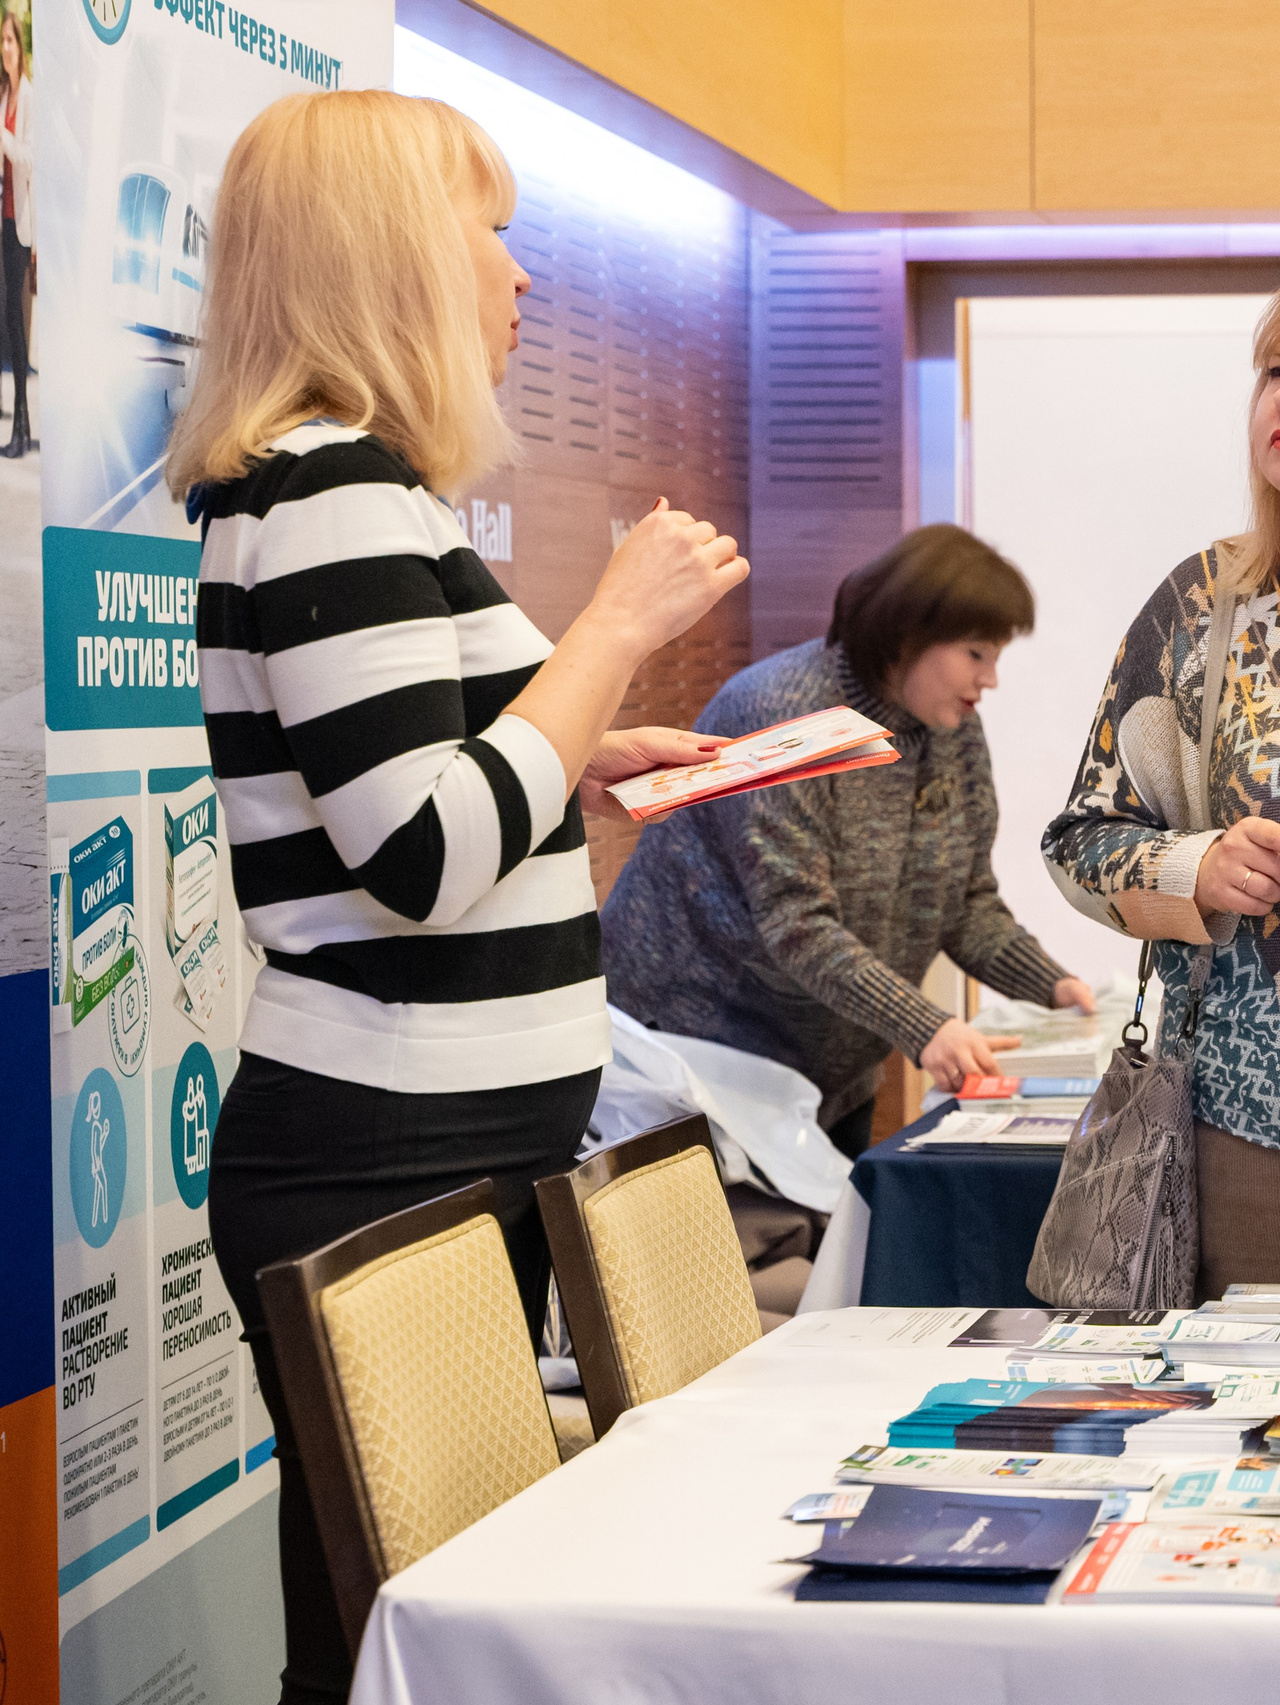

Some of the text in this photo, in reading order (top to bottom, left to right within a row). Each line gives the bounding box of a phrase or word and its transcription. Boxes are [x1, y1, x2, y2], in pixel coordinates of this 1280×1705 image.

[228, 7, 276, 65] ЧЕРЕЗ
[279, 33, 287, 70] 5
[472, 499, 513, 562] Hall
[77, 636, 199, 688] ПРОТИВ БО
[182, 802, 209, 845] ОКИ
[61, 1272, 116, 1322] АКТИВНЫЙ
[162, 1268, 202, 1305] ПАЦИЕНТ
[62, 1310, 108, 1352] ПАЦИЕНТ
[162, 1295, 203, 1333] ХОРОШАЯ
[162, 1310, 232, 1362] ПЕРЕНОСИМОСТЬ
[63, 1327, 129, 1381] РАСТВОРЕНИЕ
[63, 1371, 96, 1410] ВО РТУ
